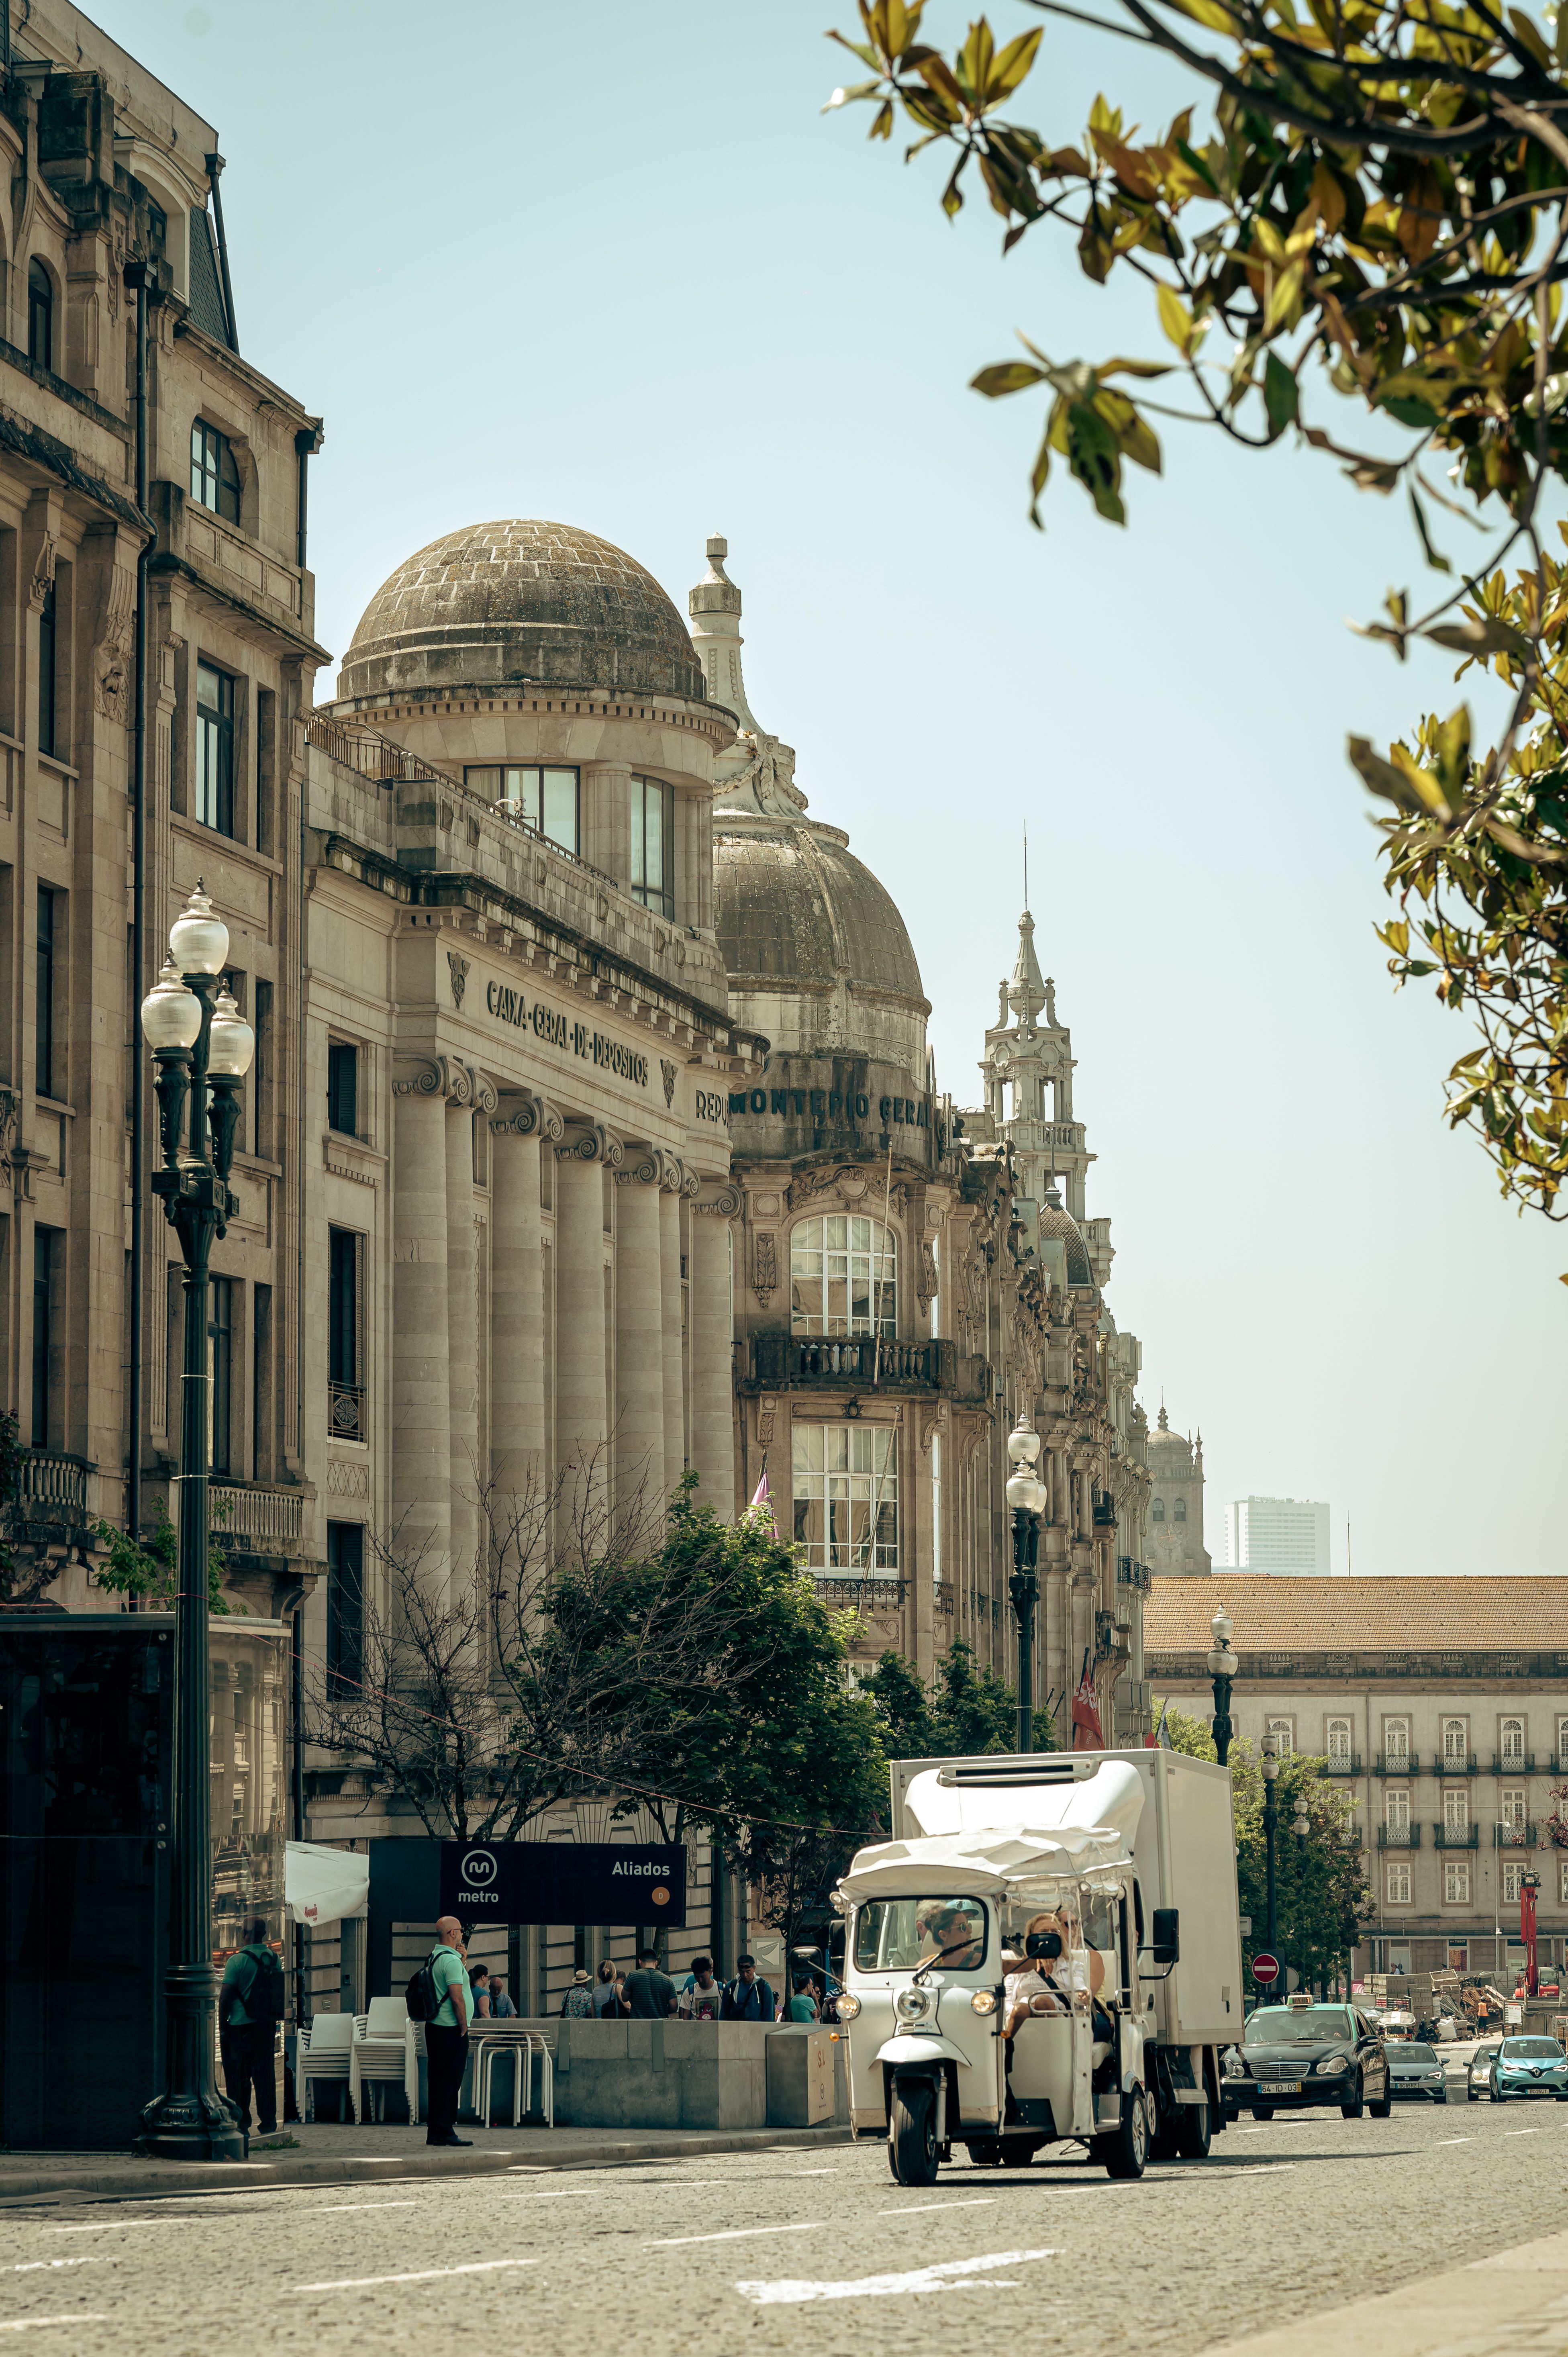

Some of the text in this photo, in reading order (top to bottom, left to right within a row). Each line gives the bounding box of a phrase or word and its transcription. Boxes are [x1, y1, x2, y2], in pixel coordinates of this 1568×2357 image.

[729, 1088, 933, 1128] MONTEPIO GERAL
[612, 1861, 670, 1875] Aliados
[458, 1891, 499, 1903] metro
